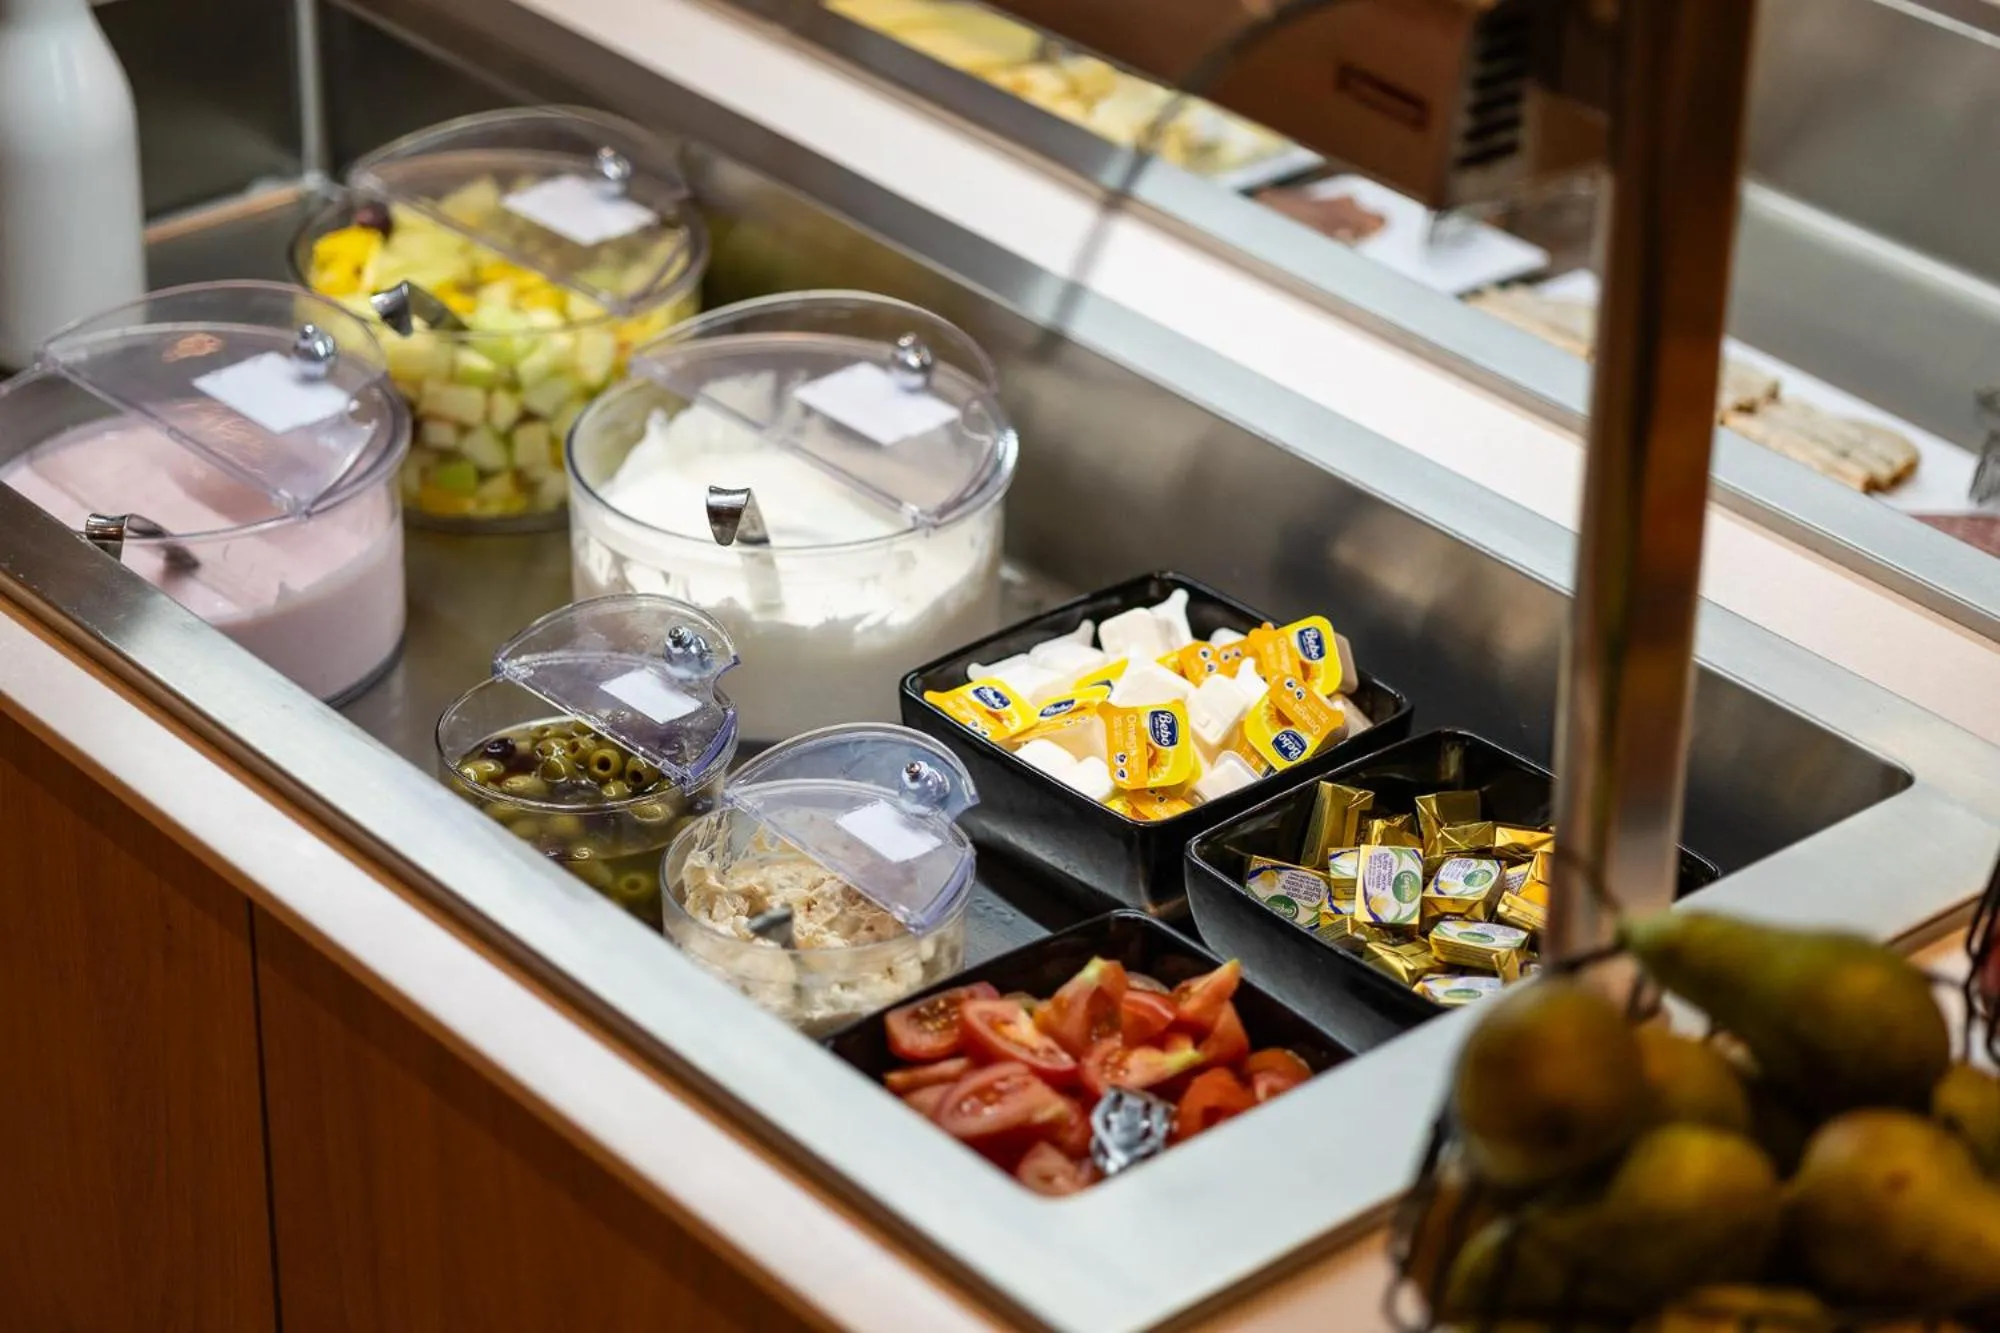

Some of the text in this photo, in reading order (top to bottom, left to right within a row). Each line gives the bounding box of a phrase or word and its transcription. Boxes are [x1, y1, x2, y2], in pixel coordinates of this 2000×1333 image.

[1304, 629, 1319, 659] Bebo
[1157, 712, 1172, 746] Bebo
[1278, 733, 1301, 760] Bebo
